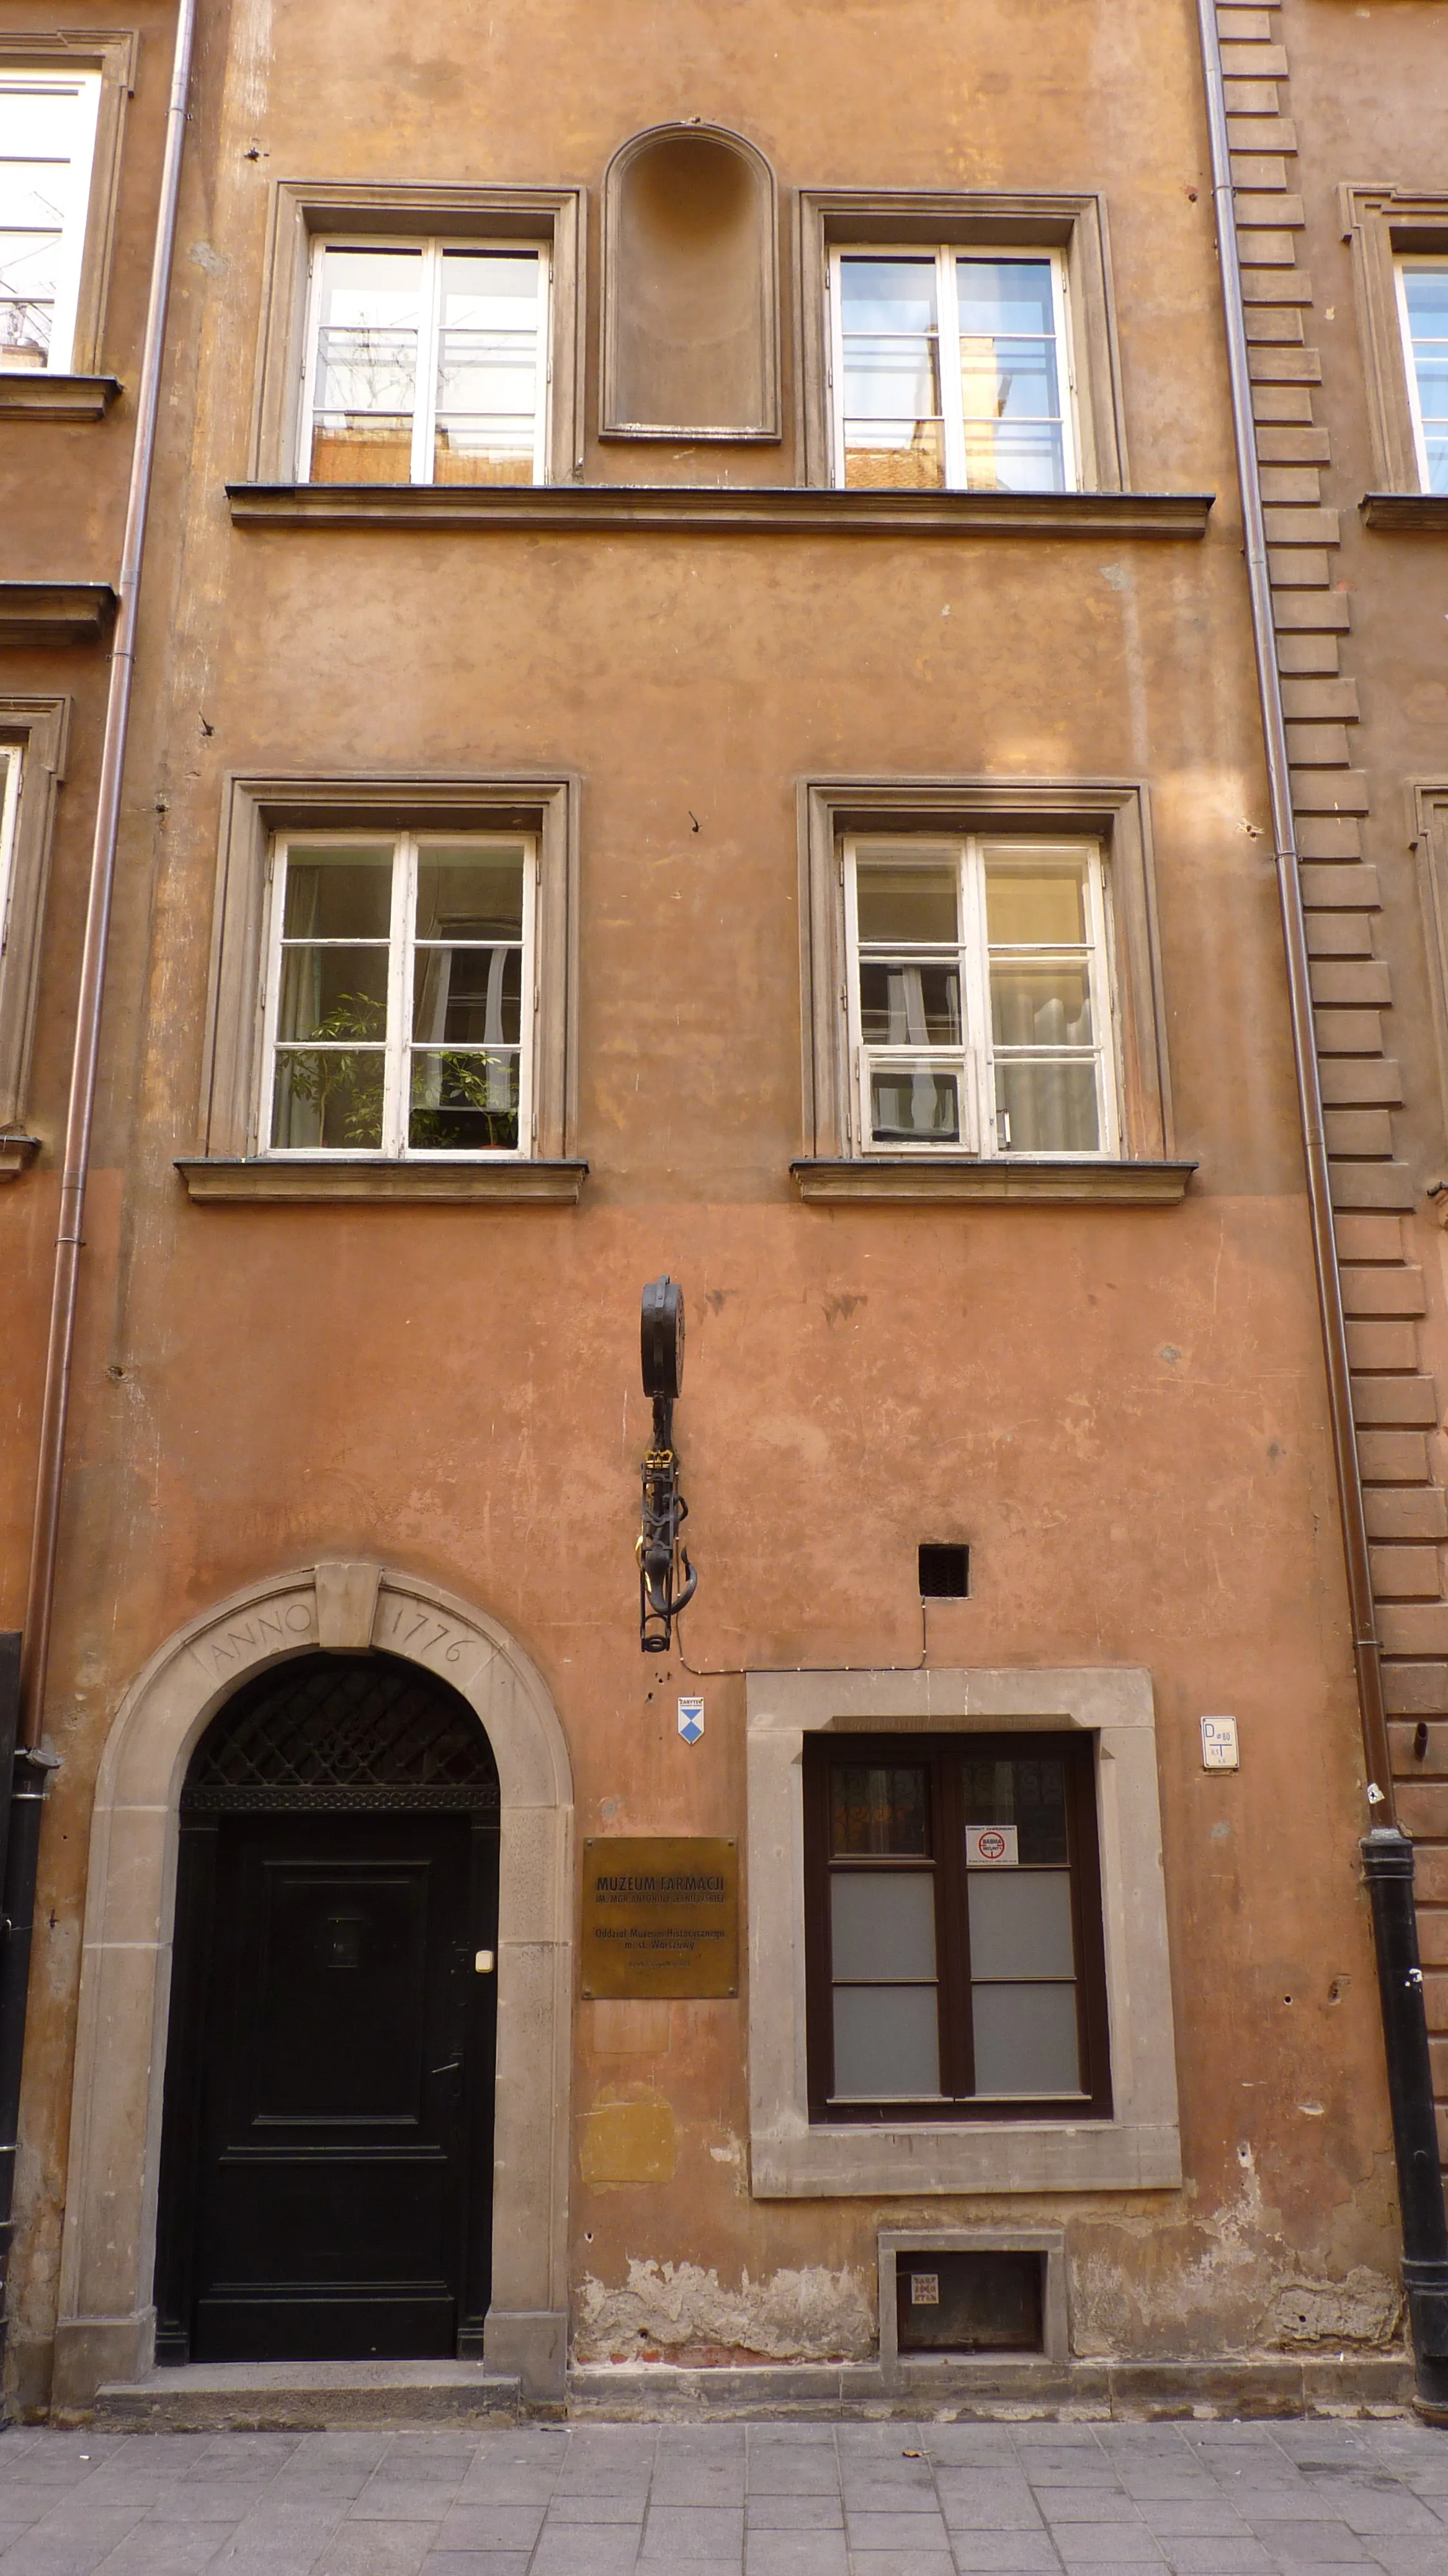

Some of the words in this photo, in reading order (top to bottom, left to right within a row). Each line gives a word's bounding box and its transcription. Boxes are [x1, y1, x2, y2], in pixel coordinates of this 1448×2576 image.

[211, 1604, 312, 1671] ANNO
[392, 1609, 477, 1662] 1776
[1205, 1724, 1214, 1738] D
[596, 1877, 656, 1891] MUZEUM
[661, 1877, 724, 1891] FARMACJI
[595, 1895, 608, 1903] IM.
[611, 1895, 627, 1903] MGR
[630, 1929, 664, 1938] Muzeum
[667, 1928, 725, 1940] Historycznego
[651, 1940, 695, 1951] Warszawy
